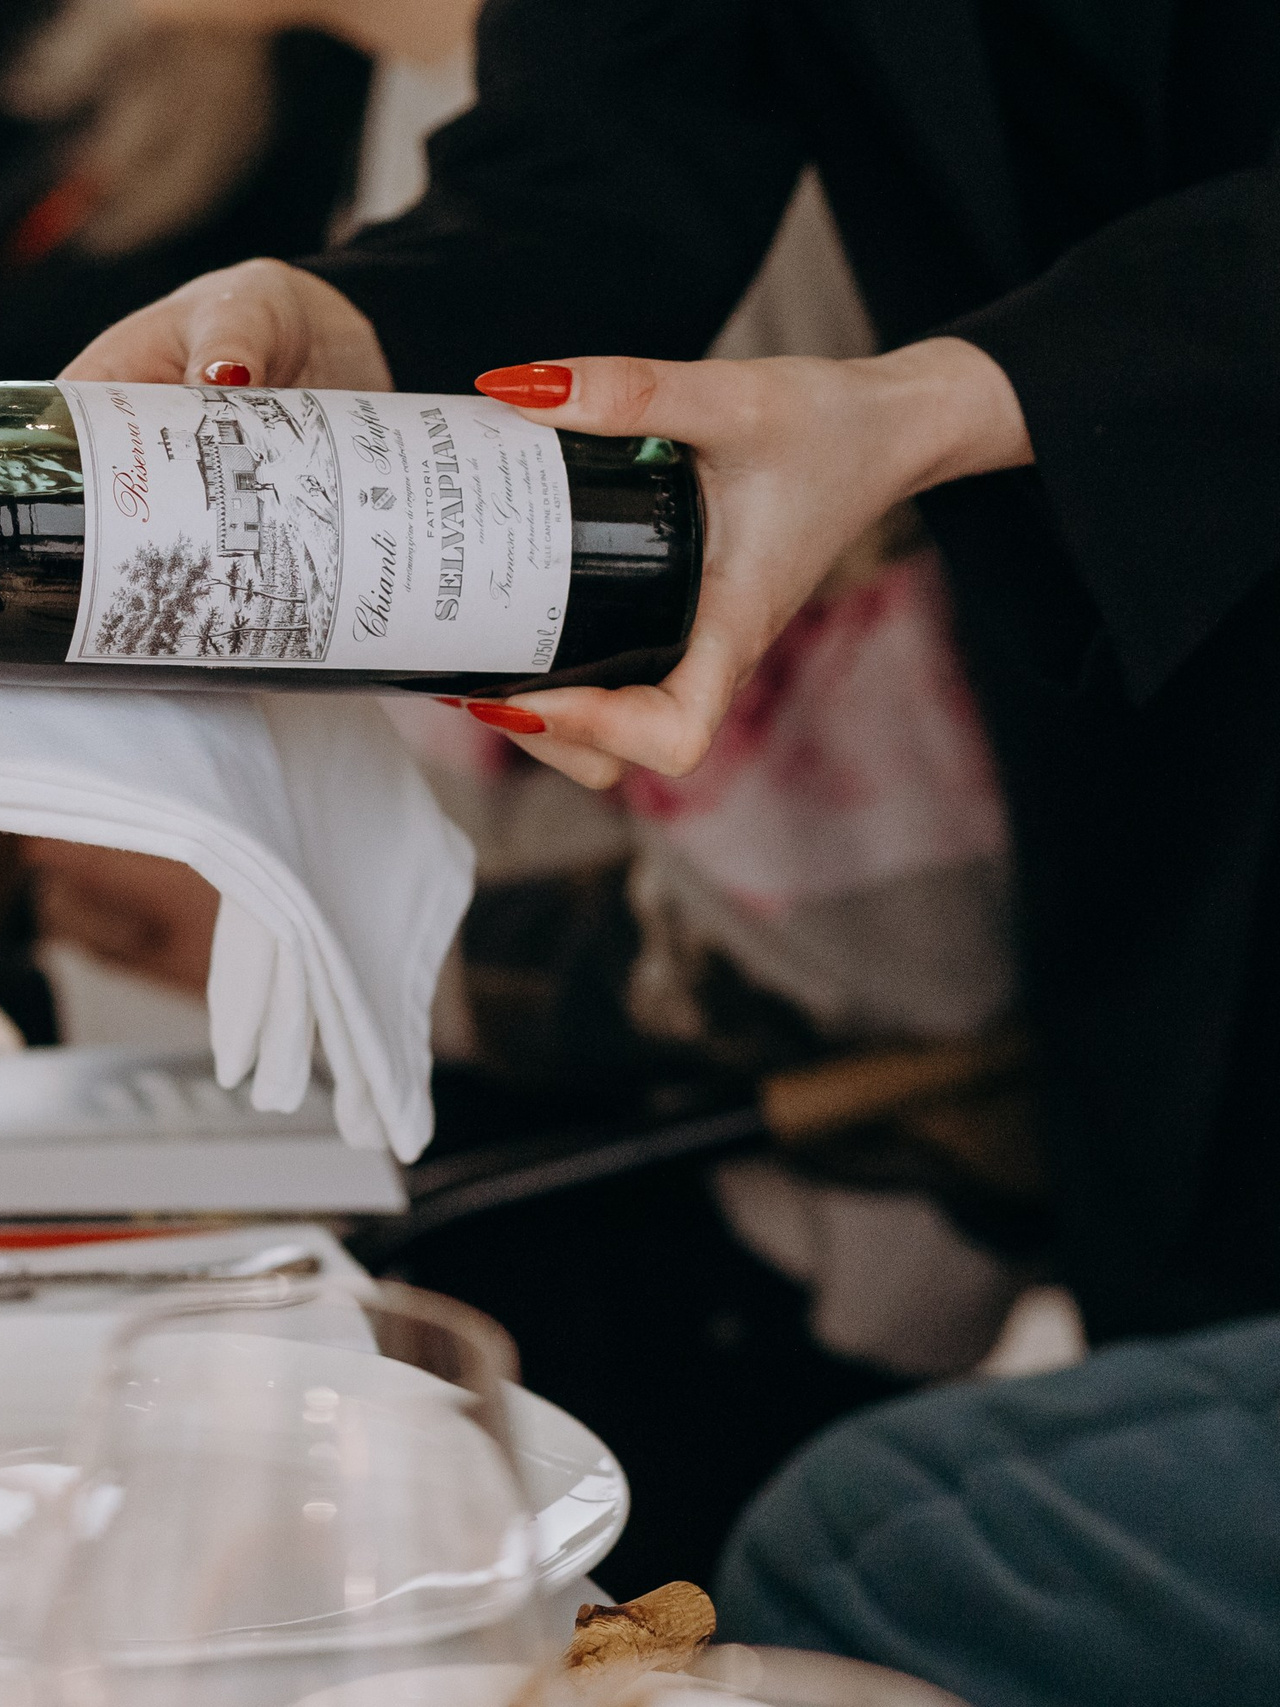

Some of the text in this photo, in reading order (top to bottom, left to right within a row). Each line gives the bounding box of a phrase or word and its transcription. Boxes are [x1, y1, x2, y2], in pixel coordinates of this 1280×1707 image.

[111, 422, 150, 523] Riserva
[405, 476, 416, 508] origine
[422, 460, 434, 538] FATTORIA
[465, 458, 479, 470] da
[346, 397, 397, 643] Chianti Rufina
[404, 509, 414, 520] di
[419, 407, 465, 621] SELVAPIANA
[534, 443, 552, 570] NELLE CANTINE DI RUFINA ITALIA
[489, 528, 515, 609] Francesco
